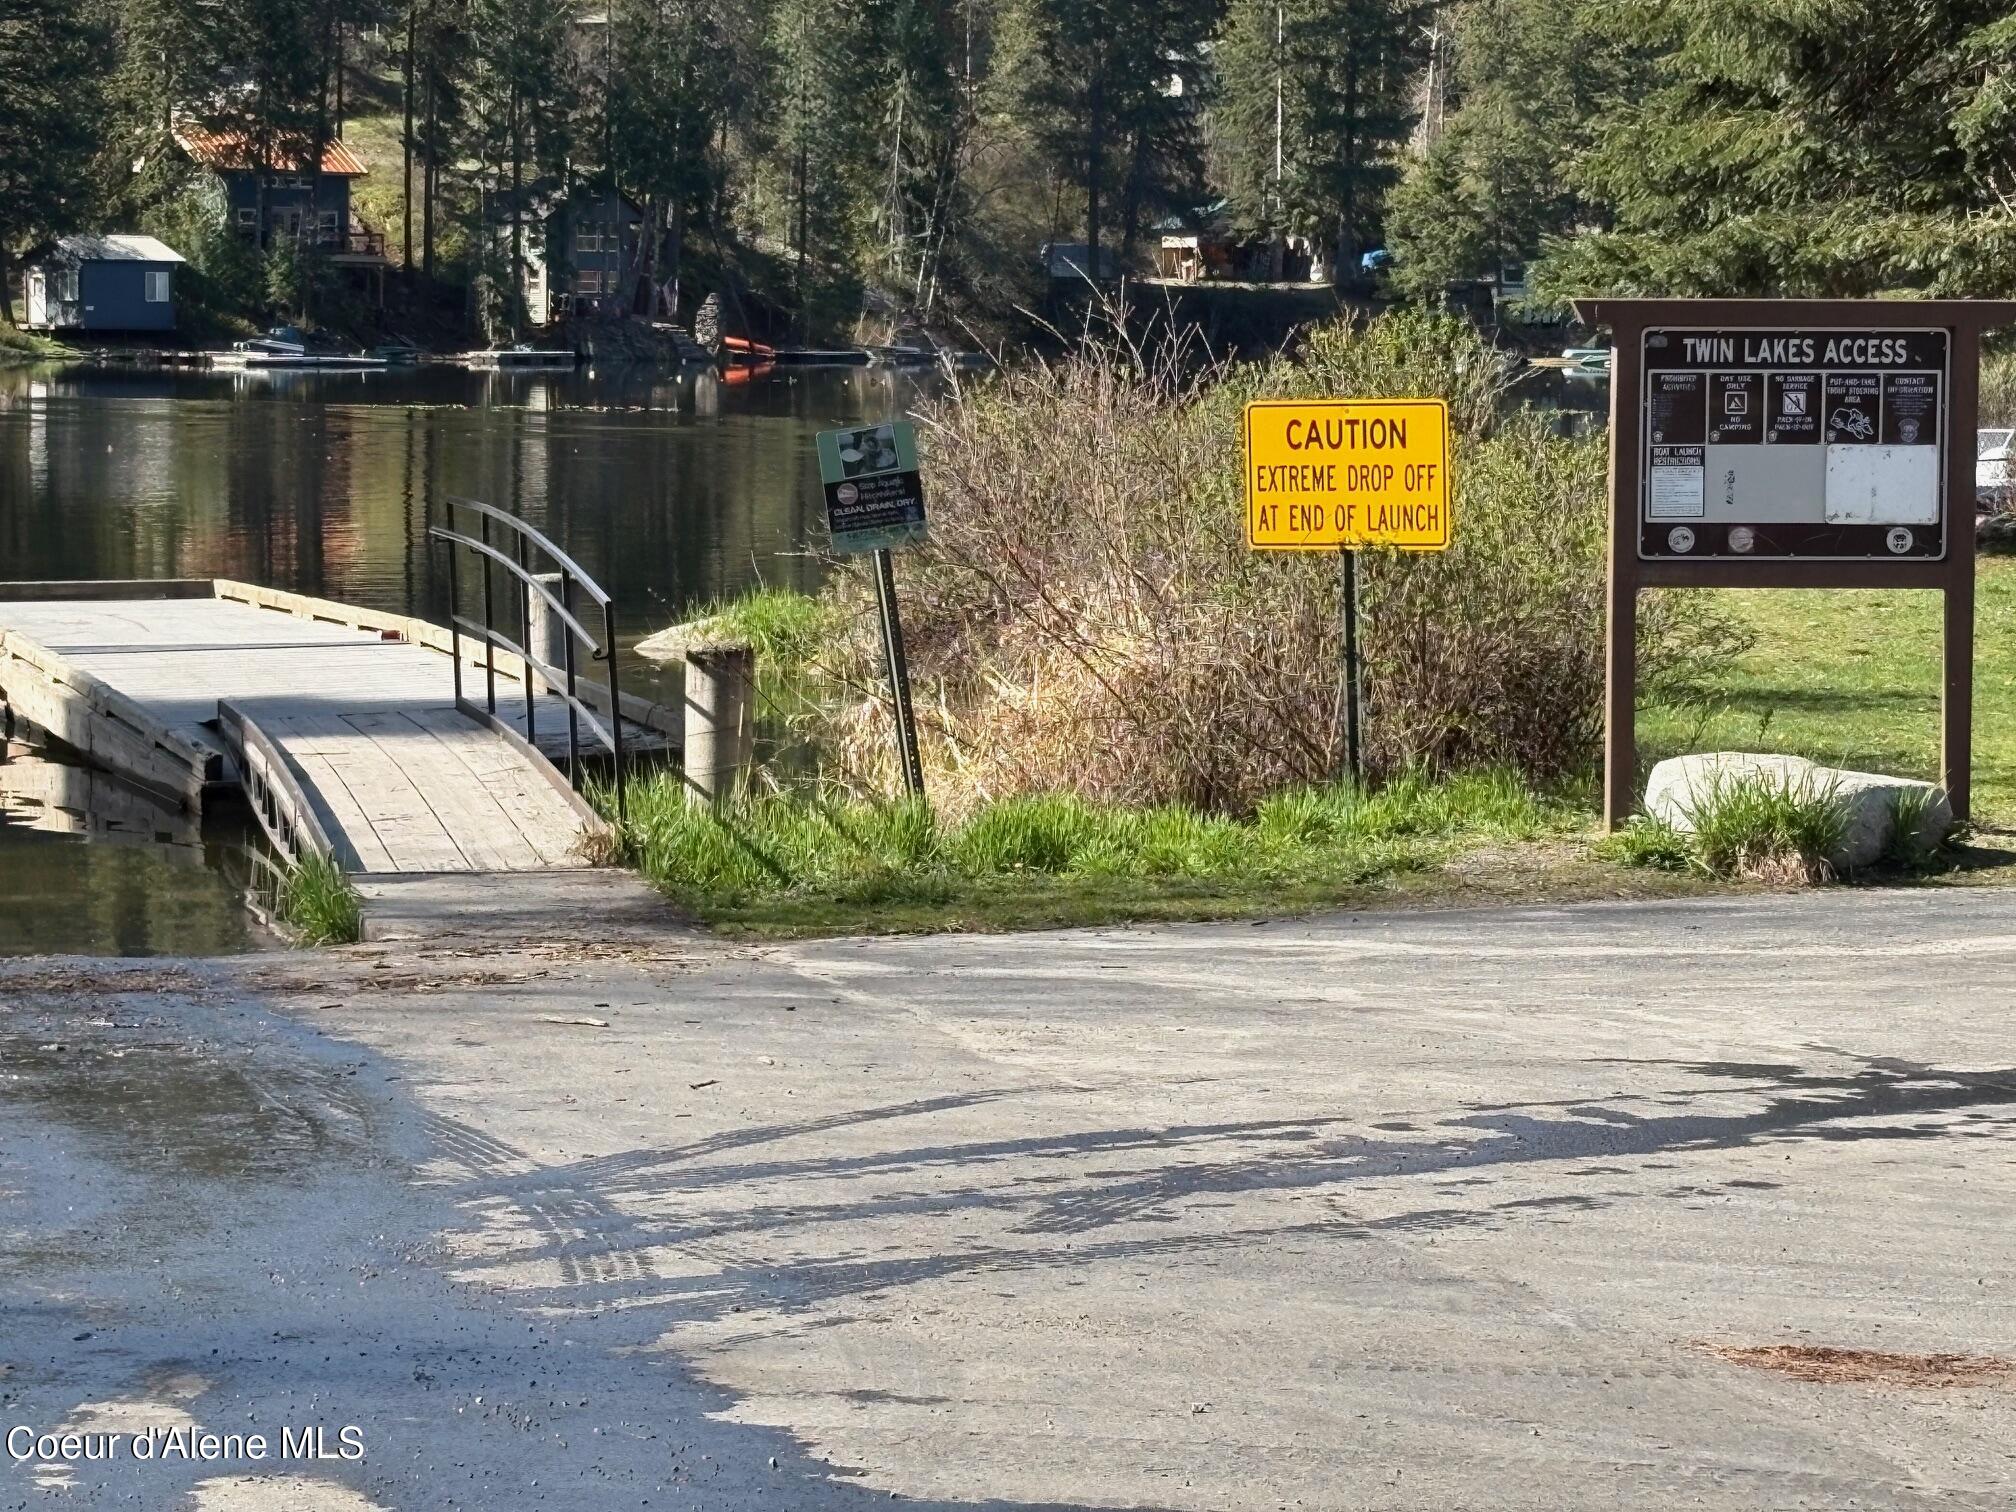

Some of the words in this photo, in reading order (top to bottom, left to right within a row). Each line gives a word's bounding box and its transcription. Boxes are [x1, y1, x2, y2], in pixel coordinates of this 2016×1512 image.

[1683, 338, 1734, 363] TWIN
[1744, 338, 1815, 363] LAKES
[1822, 338, 1907, 363] ACCESS
[1895, 377, 1925, 385] CONTACT
[1783, 382, 1808, 390] SERVICE
[1887, 386, 1934, 394] INFORMATION
[1848, 387, 1879, 395] STOCKING
[1286, 418, 1407, 450] CAUTION
[1653, 447, 1670, 456] BOAT
[1674, 447, 1702, 456] LAUNCH
[1653, 457, 1701, 466] RESTRICTIONS
[1257, 465, 1337, 492] EXTREME
[1348, 464, 1394, 491] DROP
[1404, 464, 1437, 491] OFF
[1258, 505, 1279, 531] AT
[1289, 505, 1324, 531] END
[1334, 504, 1356, 531] OF
[1367, 504, 1439, 531] LAUNCH
